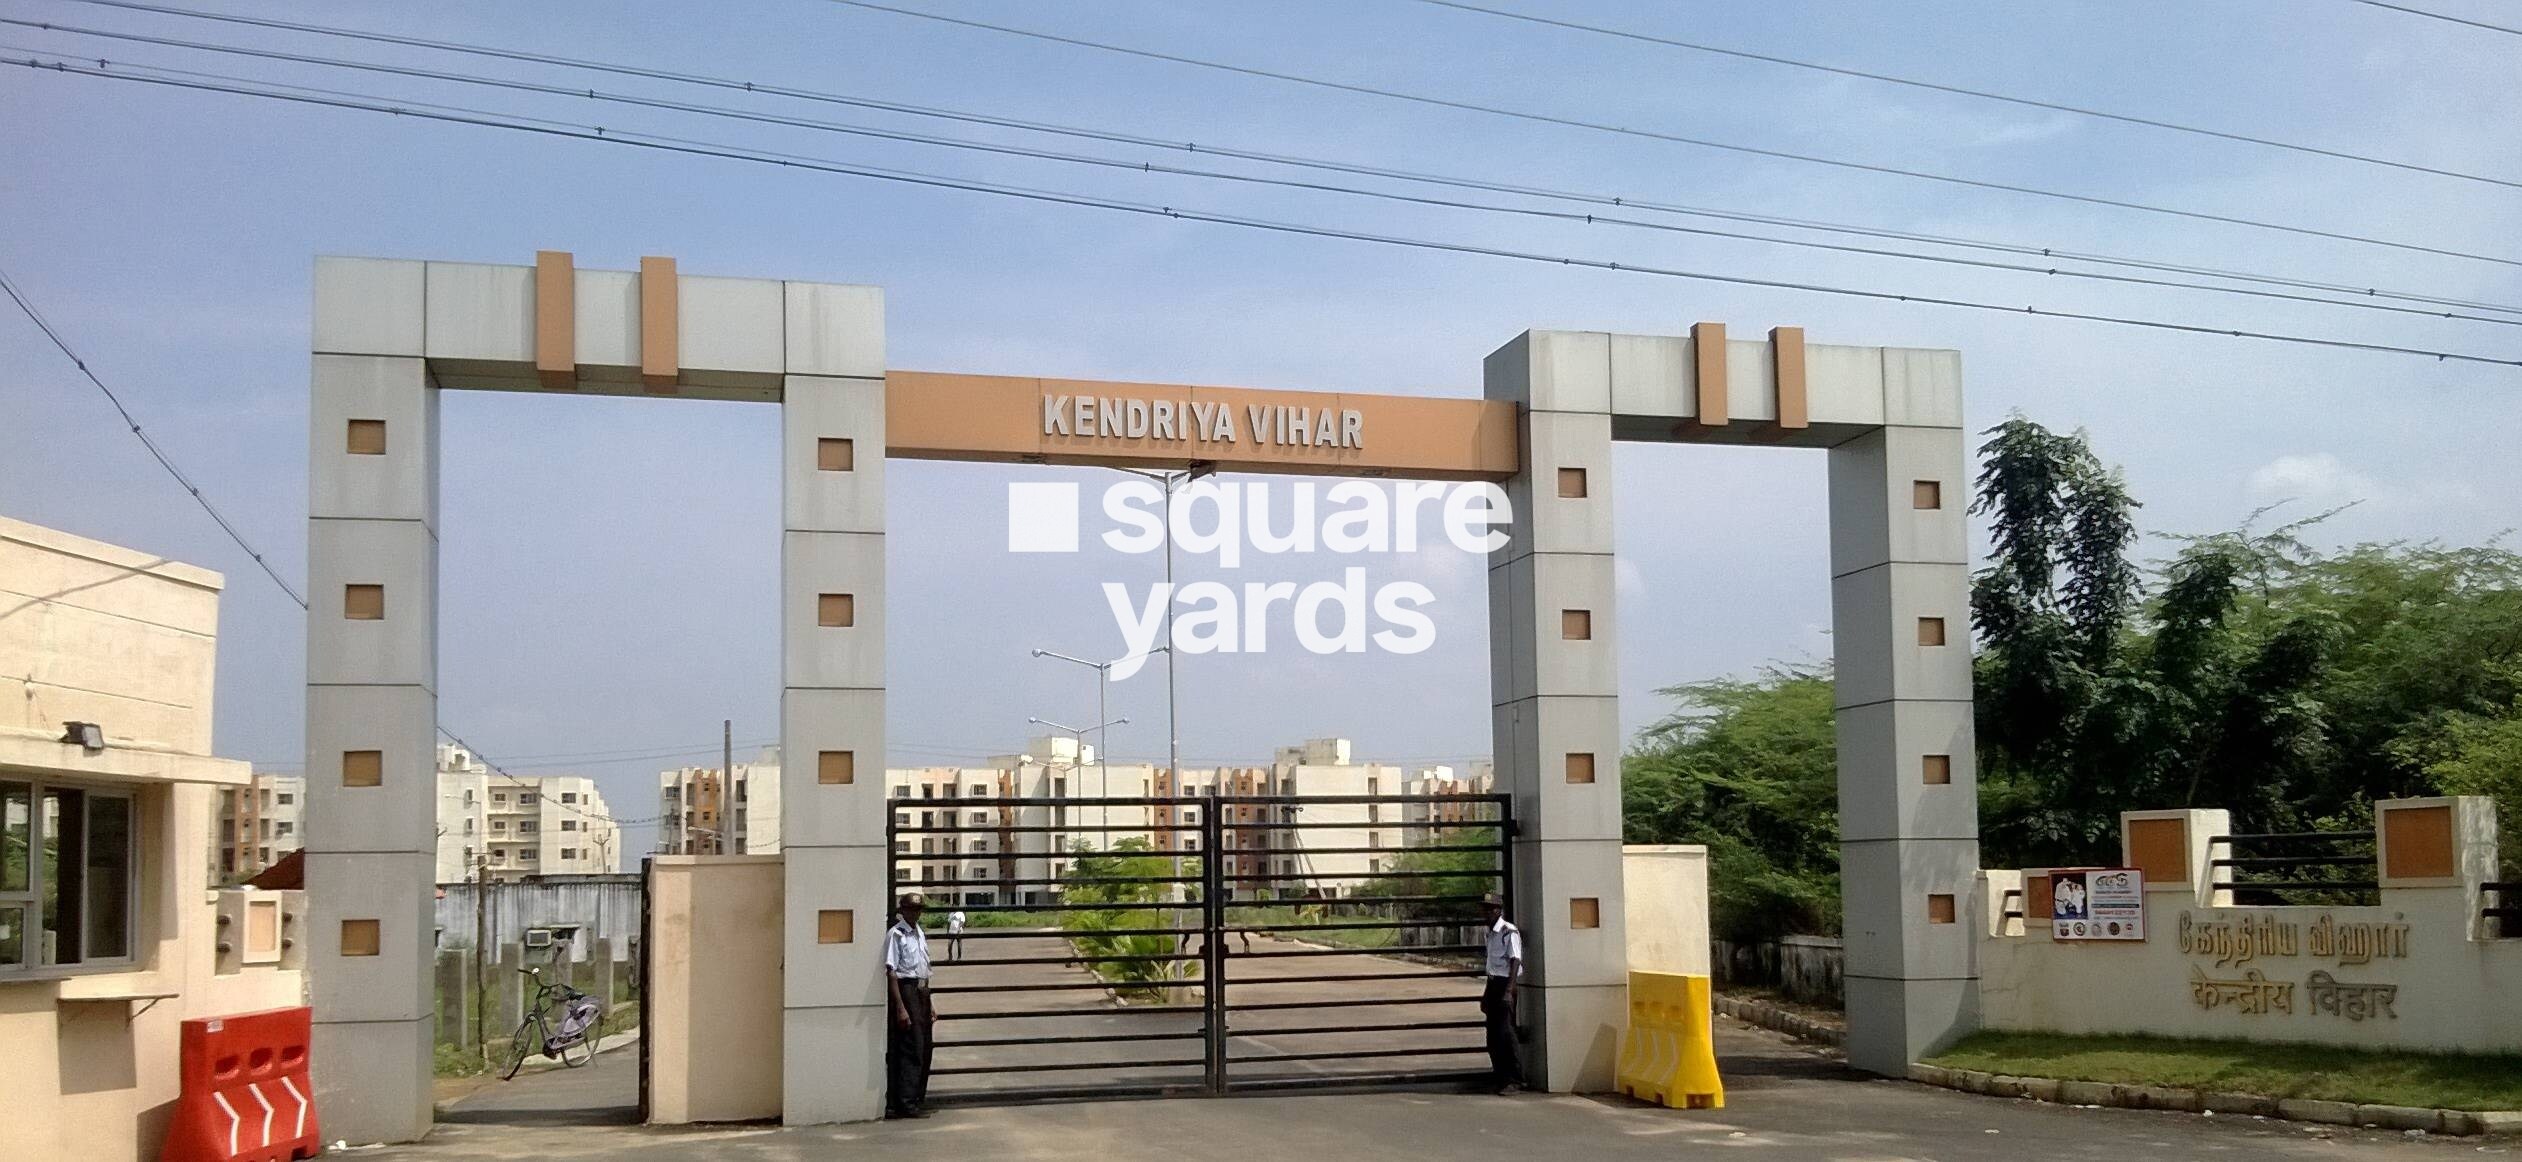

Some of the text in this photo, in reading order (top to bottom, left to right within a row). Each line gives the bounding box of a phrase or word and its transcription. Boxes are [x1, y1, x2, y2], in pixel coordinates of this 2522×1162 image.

[1044, 394, 1364, 450] KENDRIYA VIHAR
[2305, 969, 2398, 1021] विहार
